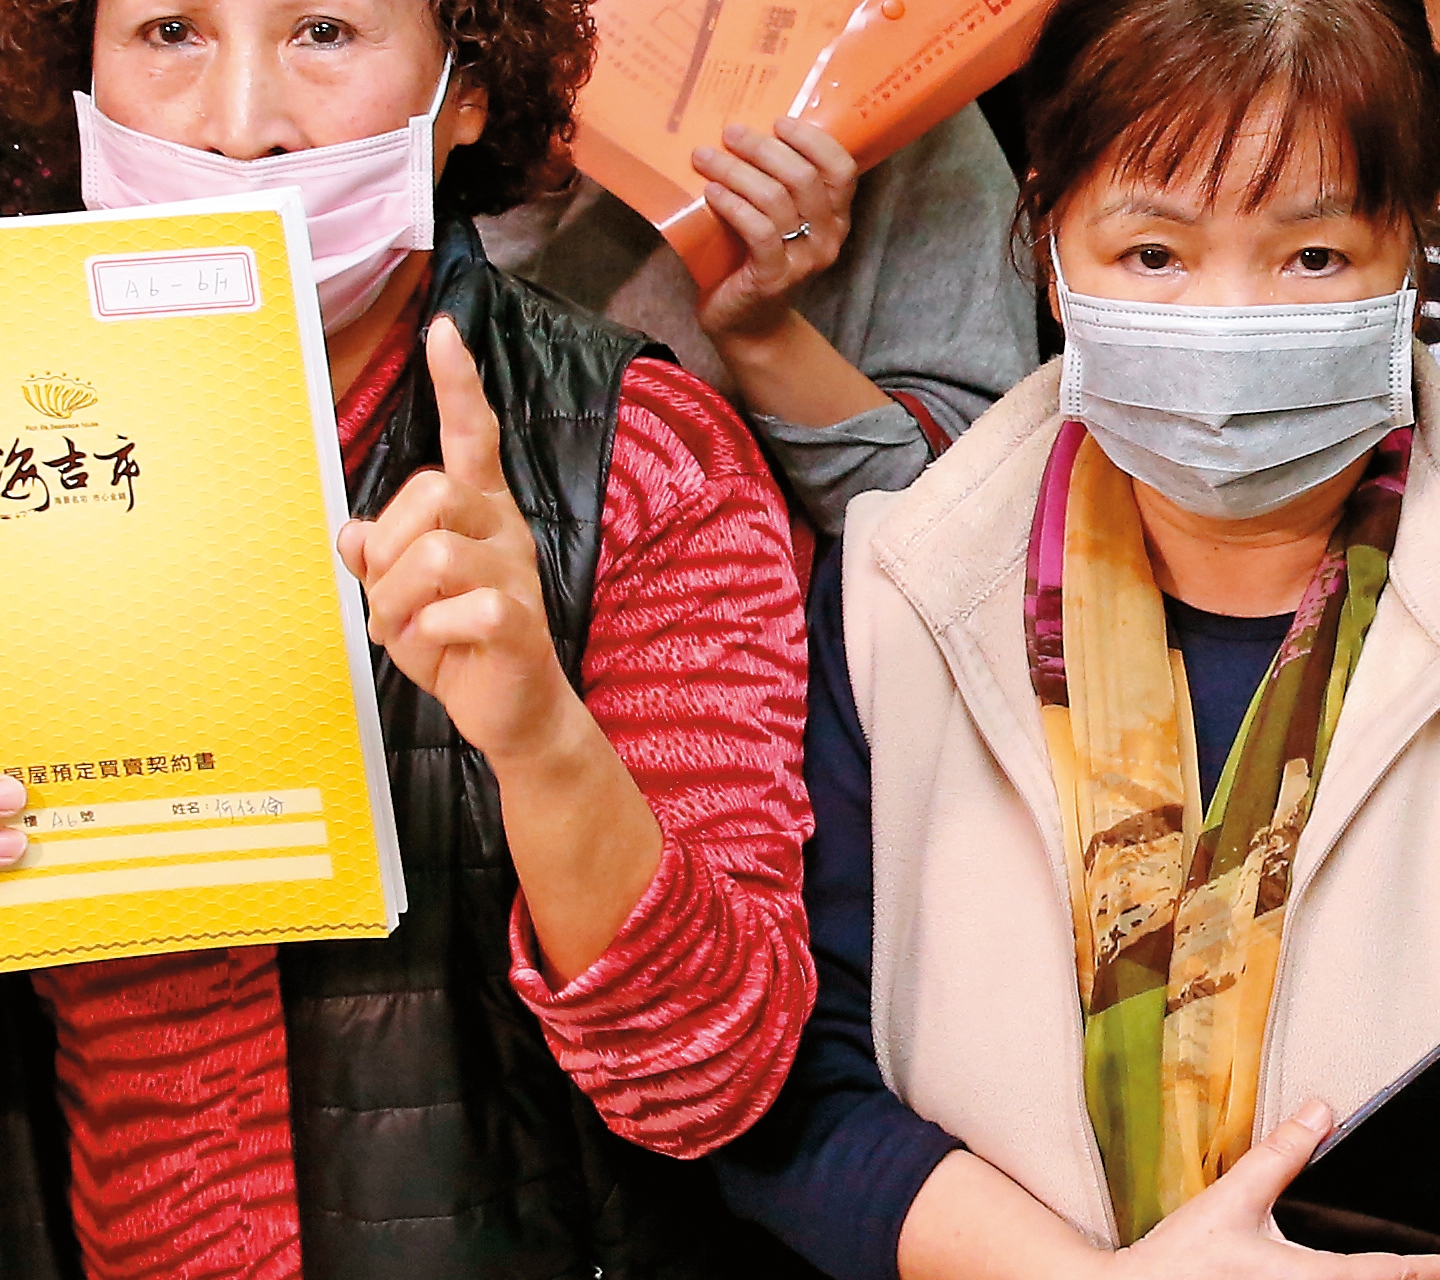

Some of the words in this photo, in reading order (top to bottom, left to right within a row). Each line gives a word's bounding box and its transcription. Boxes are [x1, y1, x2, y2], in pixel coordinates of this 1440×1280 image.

[3, 751, 216, 786] 房屋預定買賣契約書
